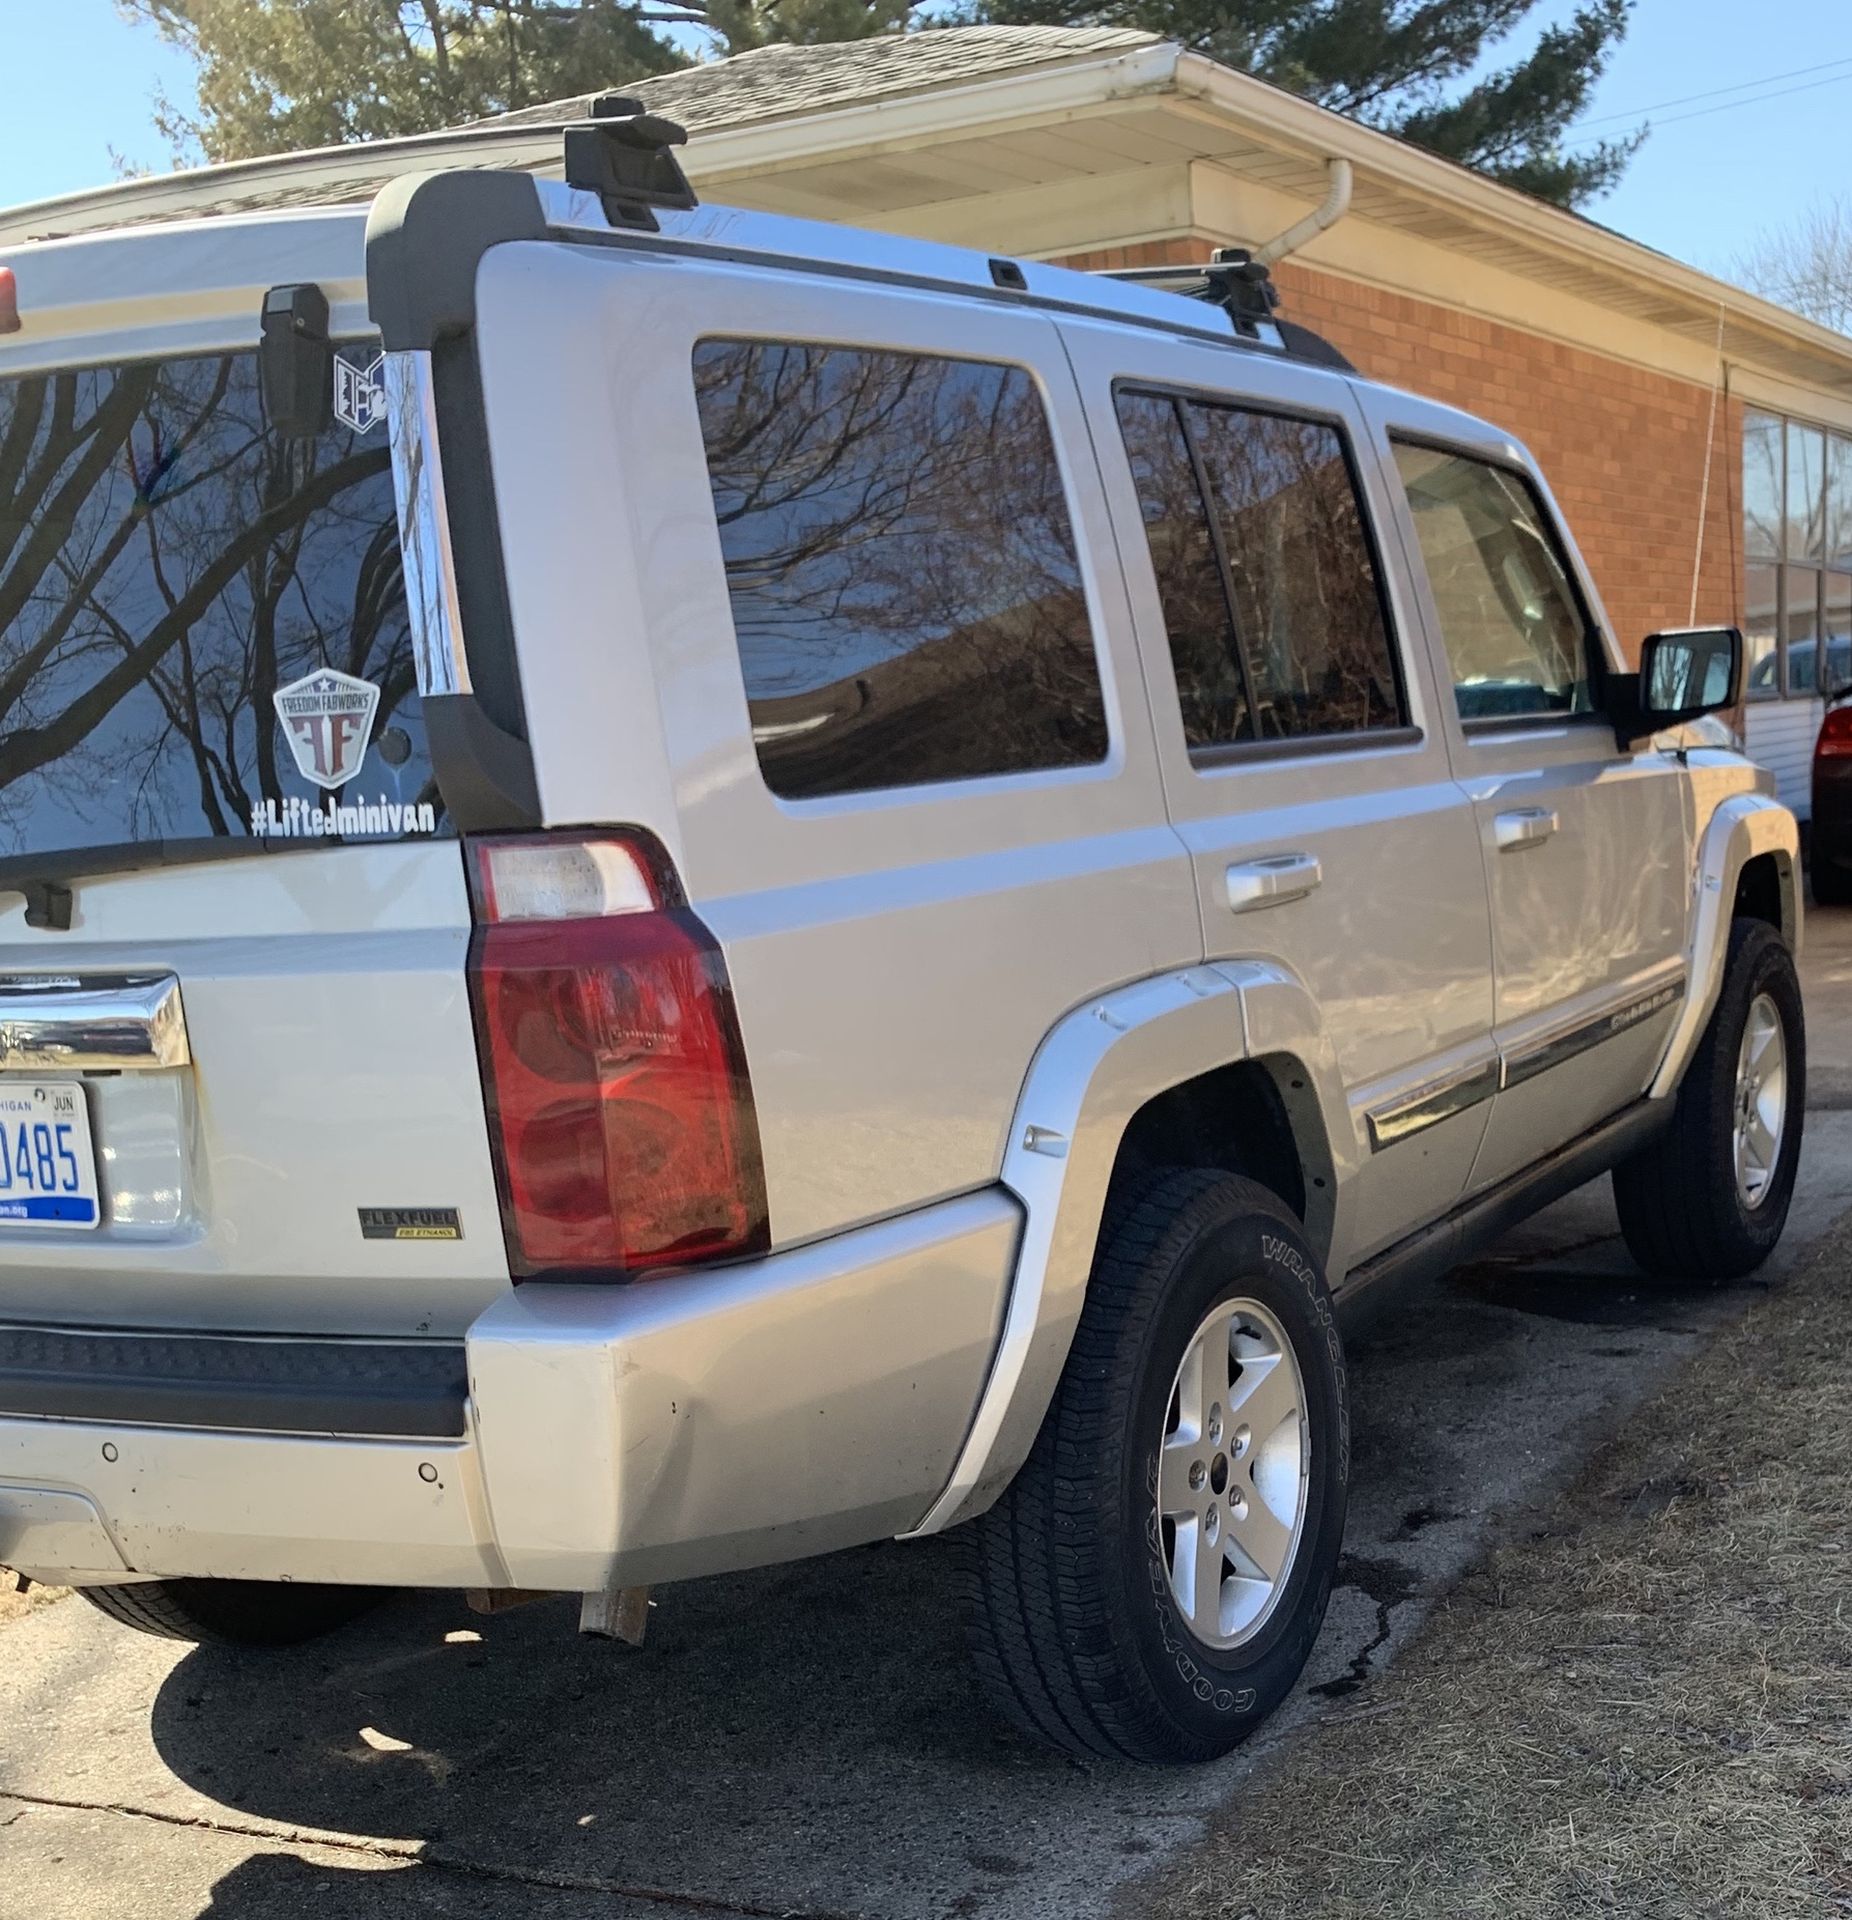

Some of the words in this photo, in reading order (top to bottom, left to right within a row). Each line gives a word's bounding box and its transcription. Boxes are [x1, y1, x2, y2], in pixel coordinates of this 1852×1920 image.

[281, 696, 320, 714] FREEDOM
[322, 693, 370, 712] FABWORKS
[251, 793, 435, 837] #Liftedminivan
[54, 1095, 74, 1112] JUN
[1261, 1234, 1350, 1487] WRANGLER
[1146, 1453, 1257, 1713] GOODYEAR
